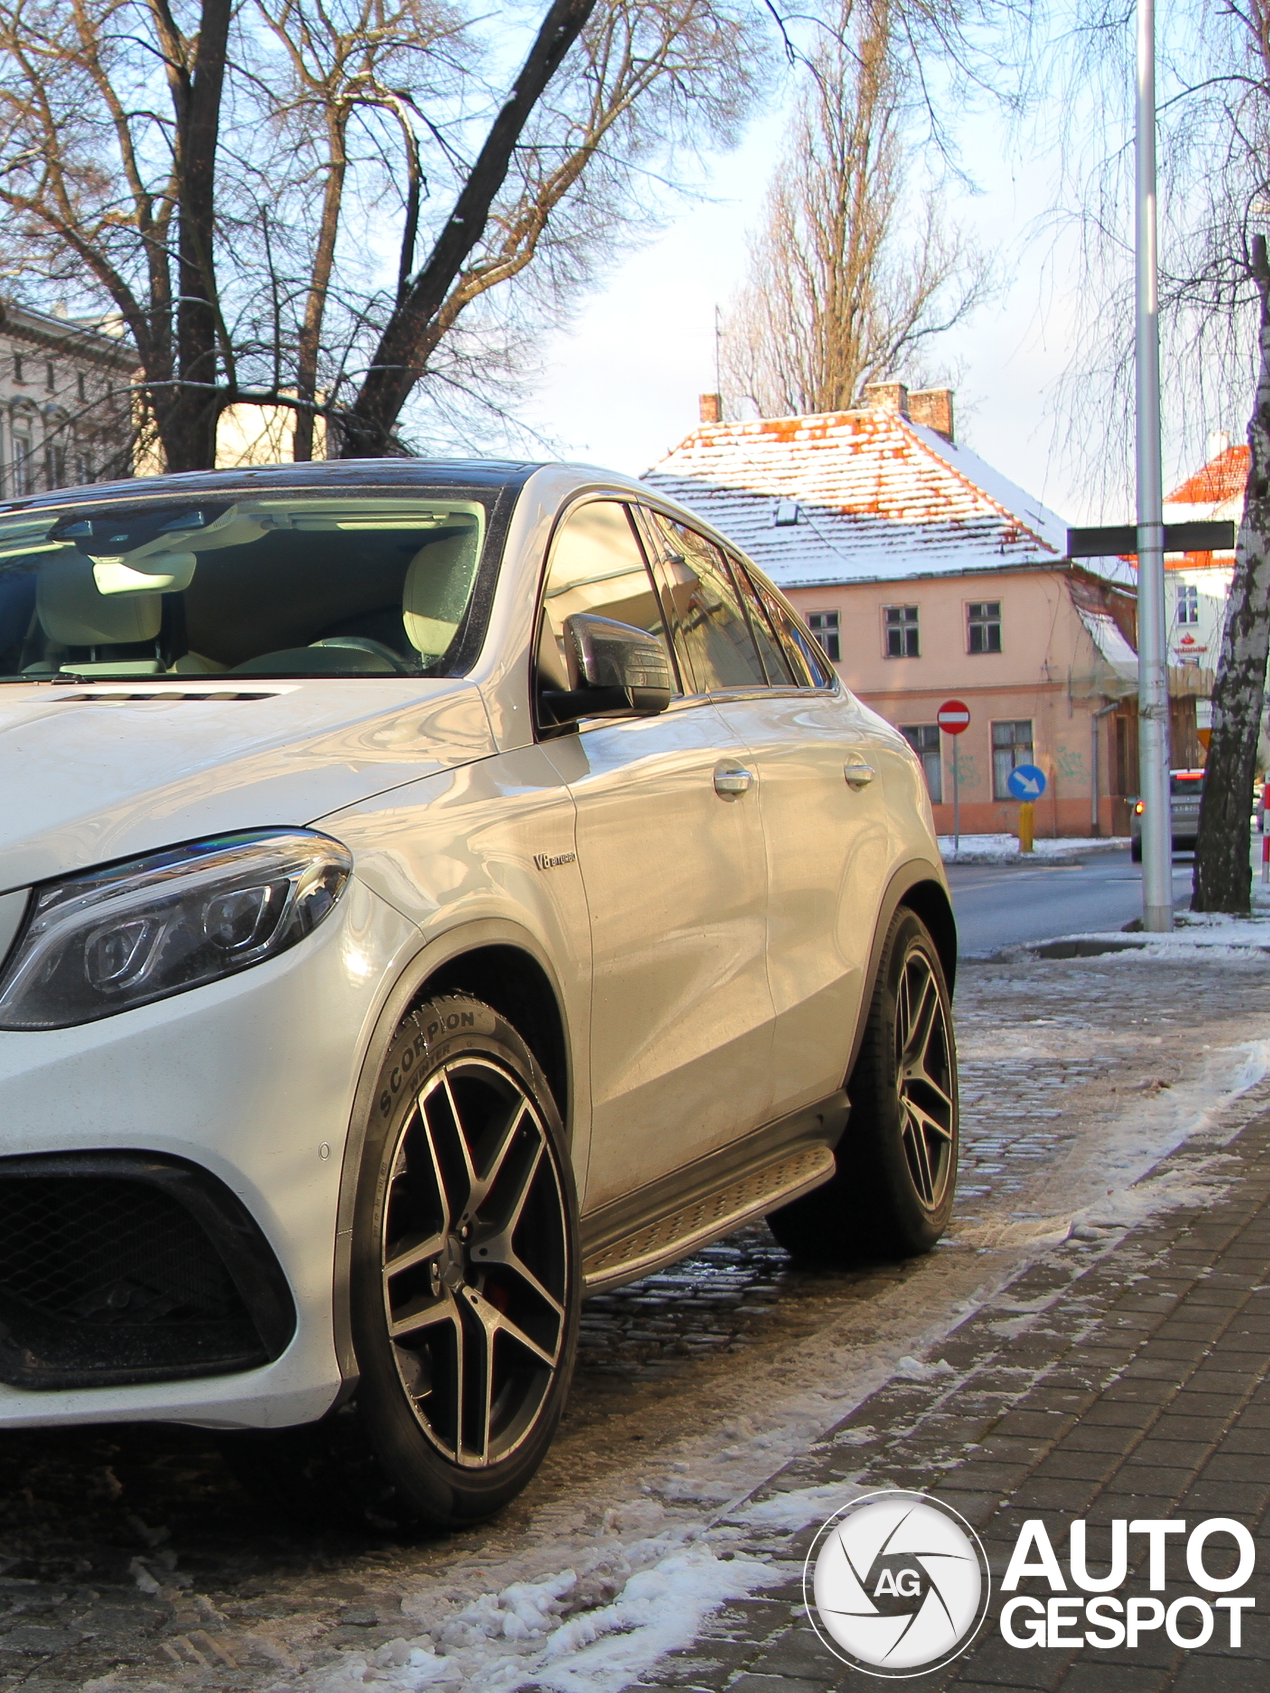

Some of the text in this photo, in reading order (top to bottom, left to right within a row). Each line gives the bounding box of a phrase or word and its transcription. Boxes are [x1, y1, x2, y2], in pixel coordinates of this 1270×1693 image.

[533, 852, 550, 871] V8
[380, 1011, 475, 1119] SCORPION
[409, 1043, 451, 1093] WINTER
